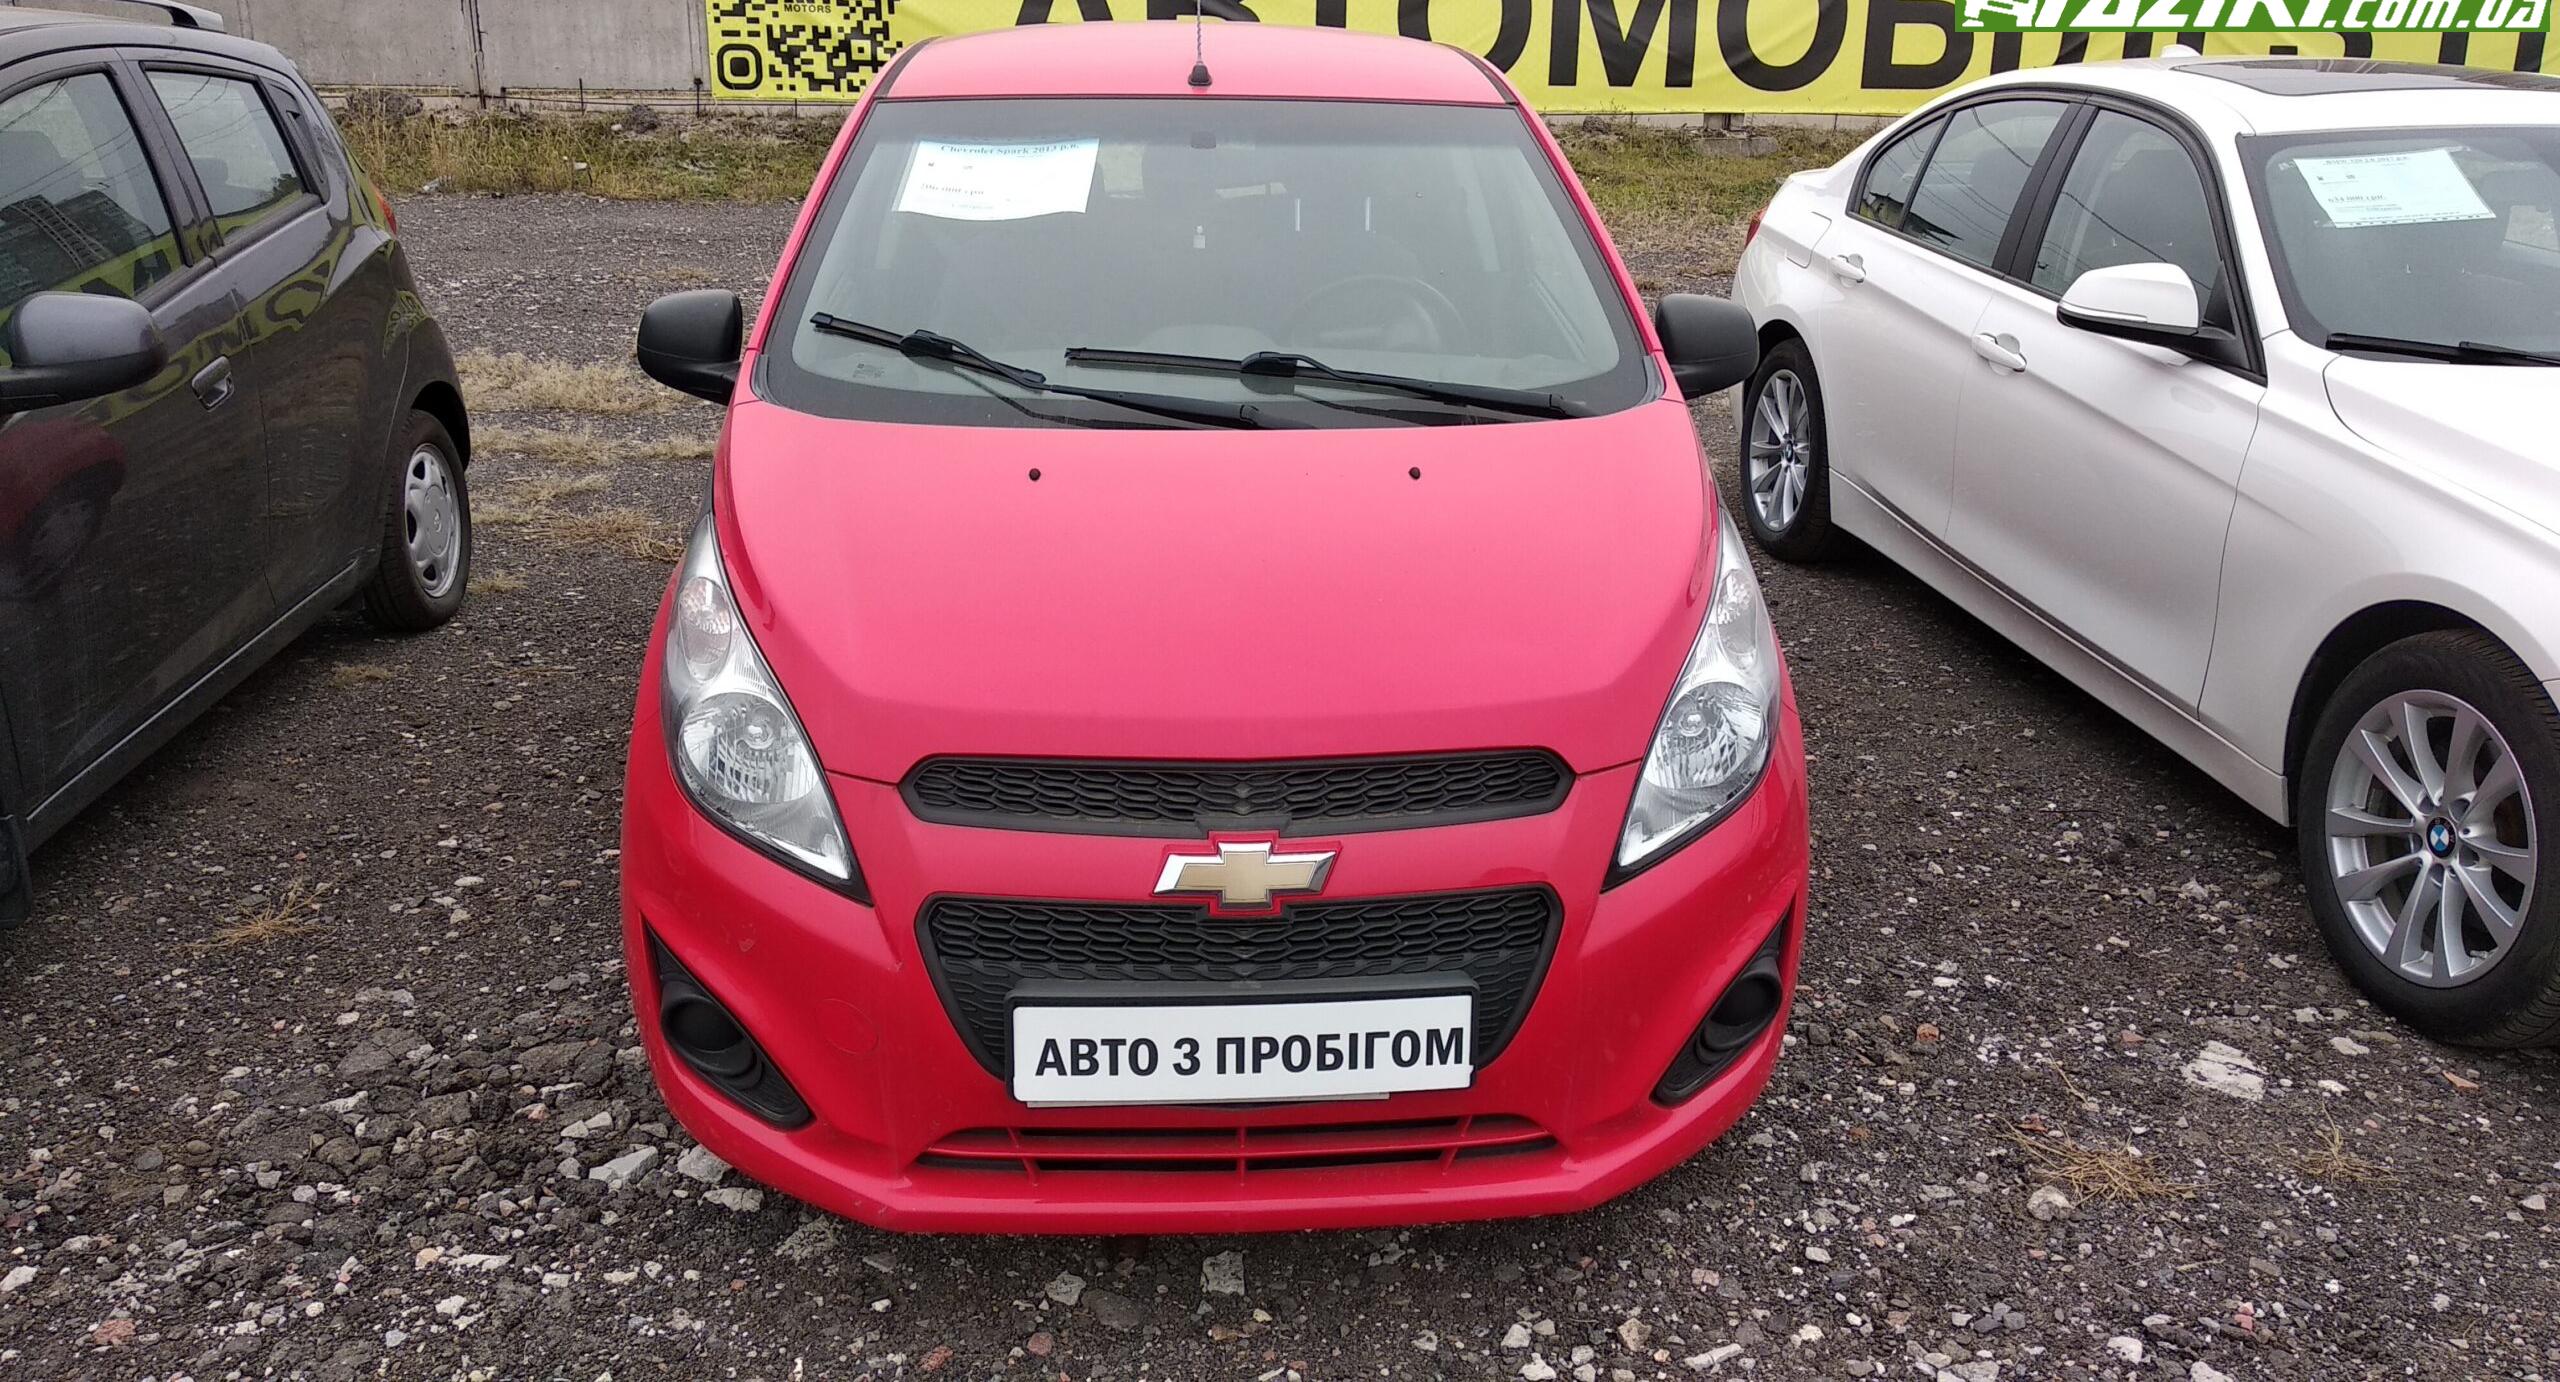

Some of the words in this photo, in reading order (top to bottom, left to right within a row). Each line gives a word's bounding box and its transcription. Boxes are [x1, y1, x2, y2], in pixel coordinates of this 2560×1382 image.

[784, 4, 831, 13] MOTORS
[940, 144, 994, 155] Chevrolet
[997, 146, 1029, 157] Spark
[1035, 1037, 1159, 1077] АВТО
[1172, 1037, 1201, 1076] З
[1216, 1027, 1464, 1075] ПРОБІГОМ
